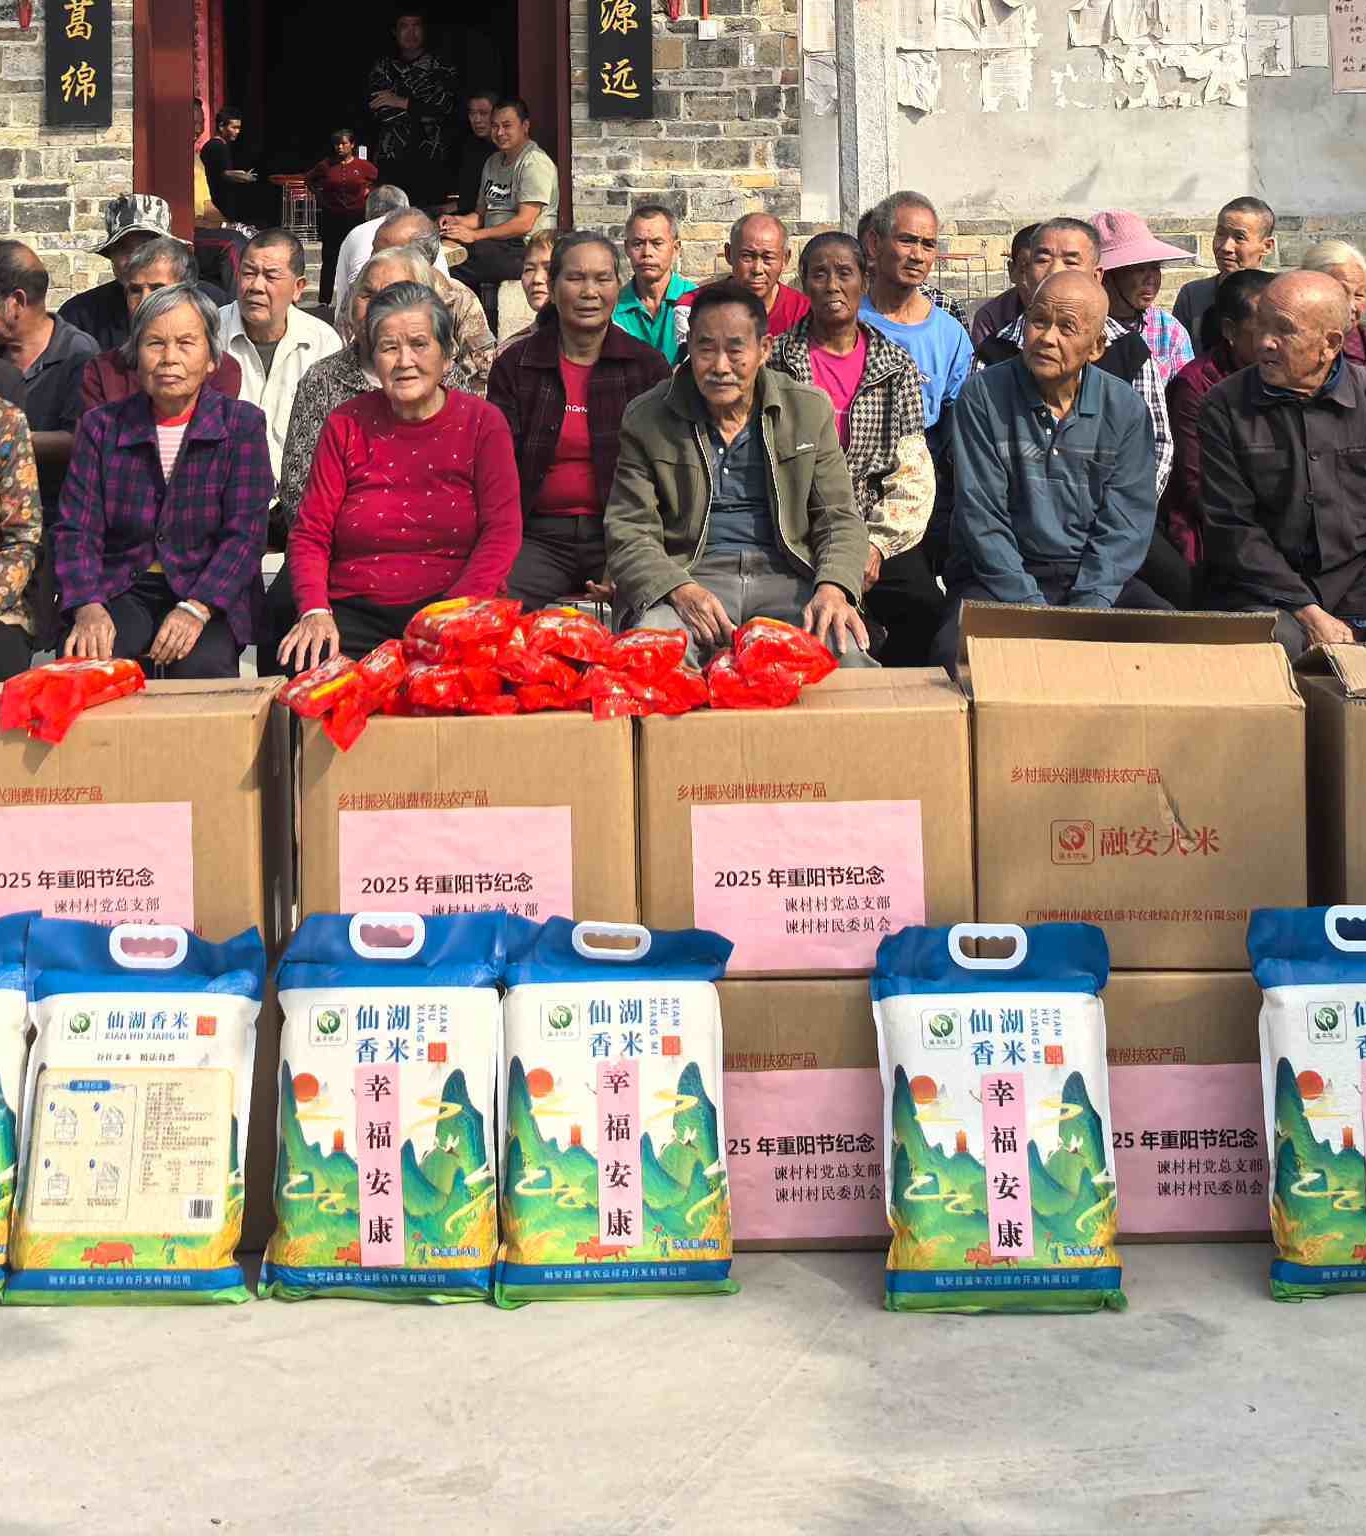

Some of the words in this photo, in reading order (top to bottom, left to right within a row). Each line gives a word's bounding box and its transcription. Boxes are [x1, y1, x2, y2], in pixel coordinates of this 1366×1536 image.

[1099, 826, 1220, 856] 融安大米
[38, 868, 154, 889] 年重阳节纪念
[361, 876, 408, 893] 2025
[415, 872, 533, 894] 年重阳节纪念
[715, 870, 761, 888] 2025
[767, 865, 885, 888] 年重阳节纪念
[107, 1011, 188, 1030] 仙湖香米
[355, 1004, 410, 1031] 仙湖
[587, 999, 643, 1024] 仙湖
[969, 1008, 1024, 1034] 仙湖
[355, 1037, 409, 1063] 香米
[588, 1031, 643, 1057] 香米
[971, 1040, 1026, 1066] 香米
[728, 1138, 751, 1156] 25
[756, 1133, 876, 1157] 年重阳节纪念
[1113, 1132, 1134, 1148] 25
[1141, 1129, 1258, 1150] 年重阳节纪念
[364, 1074, 393, 1244] 幸福安康
[603, 1070, 633, 1236] 幸福安康
[988, 1079, 1023, 1248] 幸福安康
